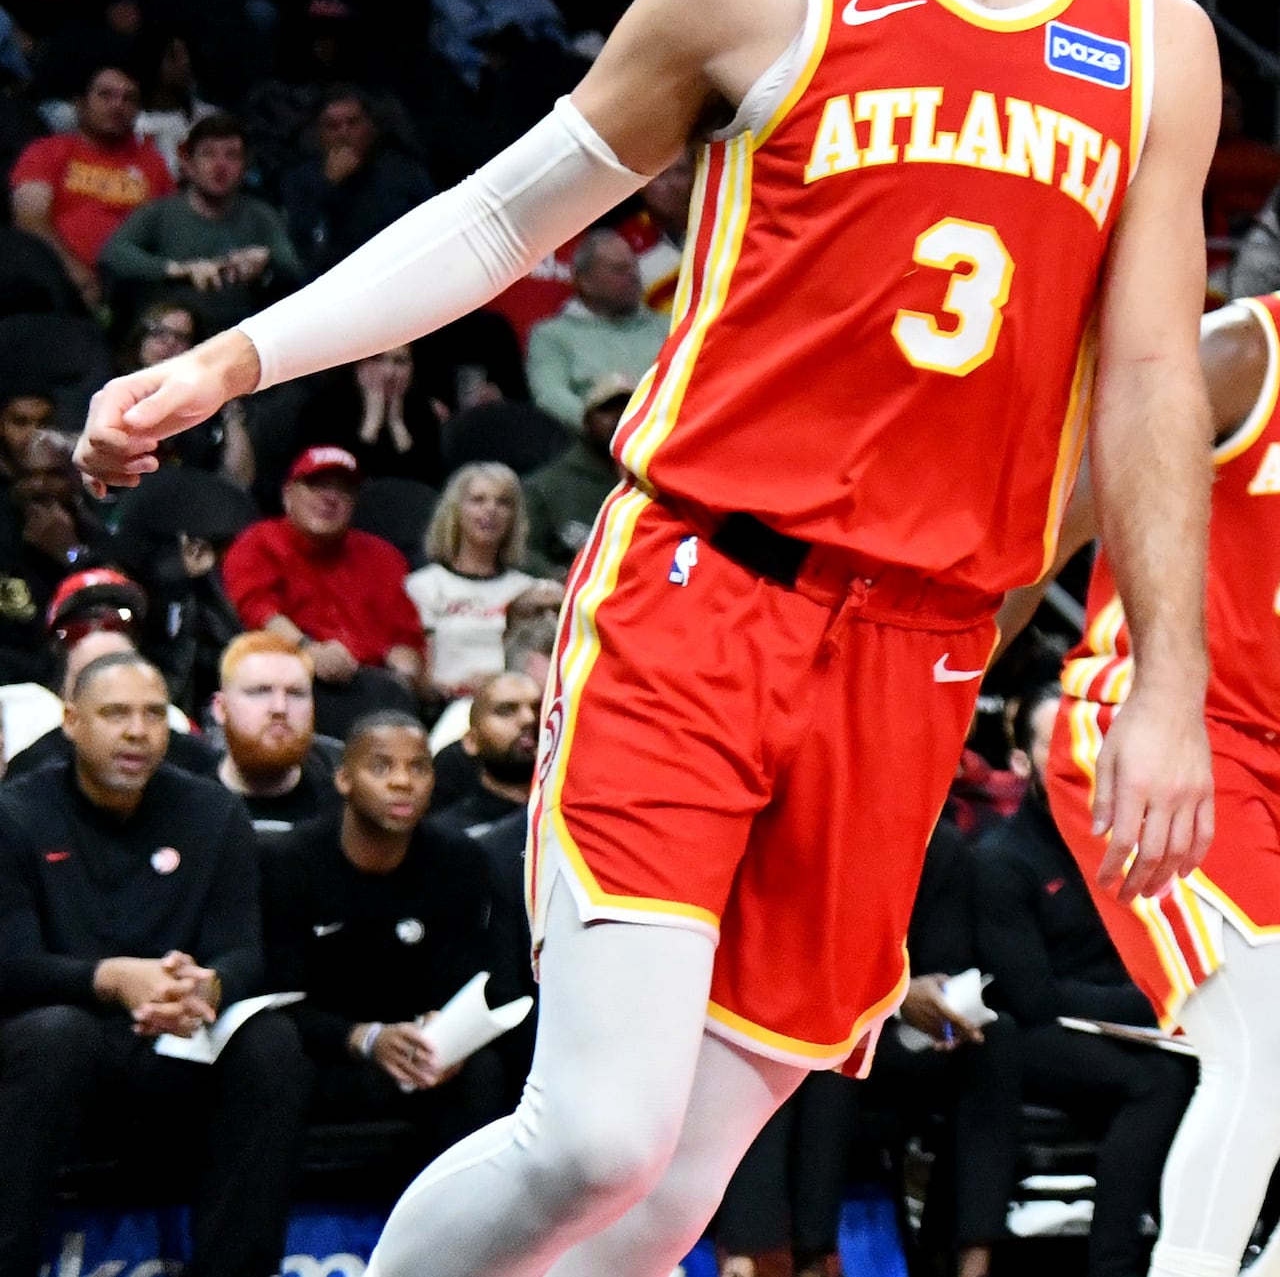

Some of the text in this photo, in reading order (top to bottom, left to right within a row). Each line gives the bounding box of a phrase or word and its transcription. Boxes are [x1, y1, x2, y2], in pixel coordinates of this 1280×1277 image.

[1052, 36, 1122, 72] paze
[804, 86, 1121, 232] ATLANTA
[890, 216, 1016, 377] 3
